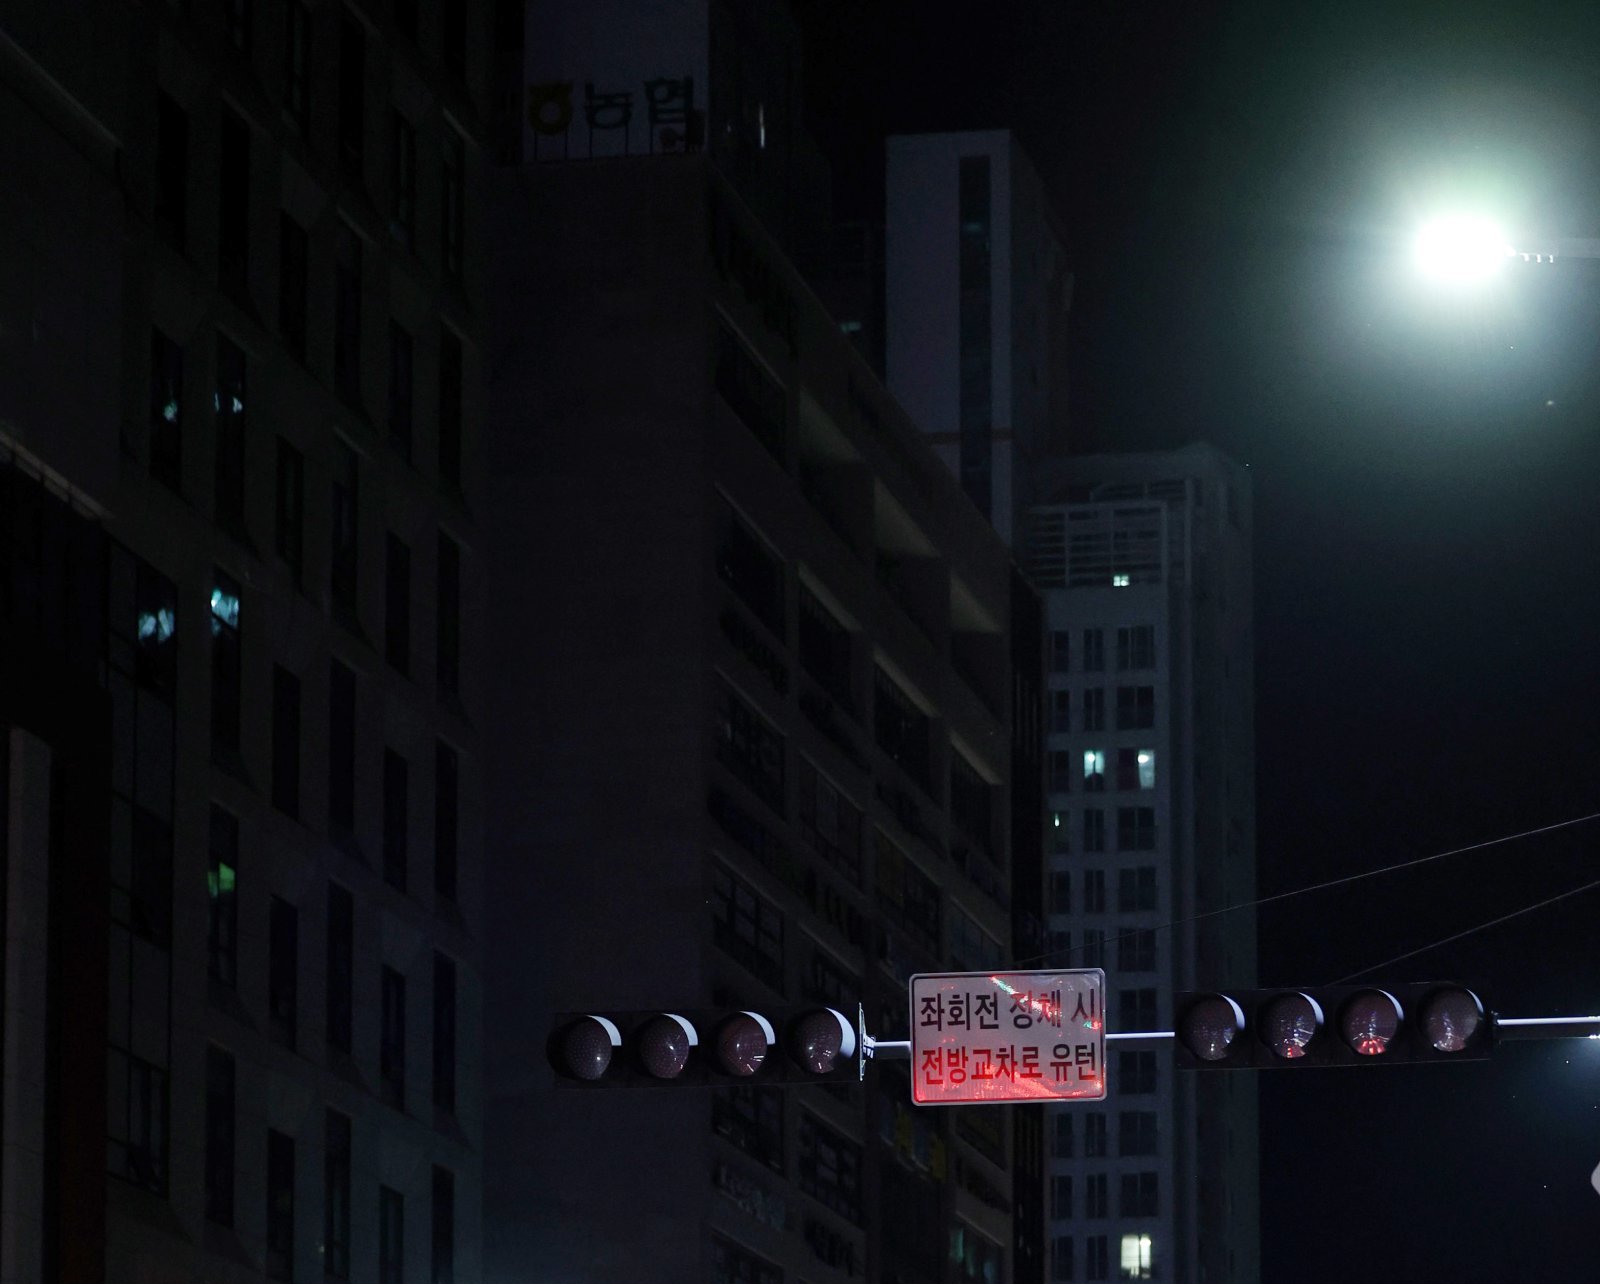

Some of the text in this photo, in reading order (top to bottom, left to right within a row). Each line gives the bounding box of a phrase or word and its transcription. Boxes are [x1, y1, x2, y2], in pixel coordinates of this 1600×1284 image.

[920, 988, 1096, 1032] 좌회전 정체 시
[921, 1042, 1096, 1085] 전방교차로 유턴
